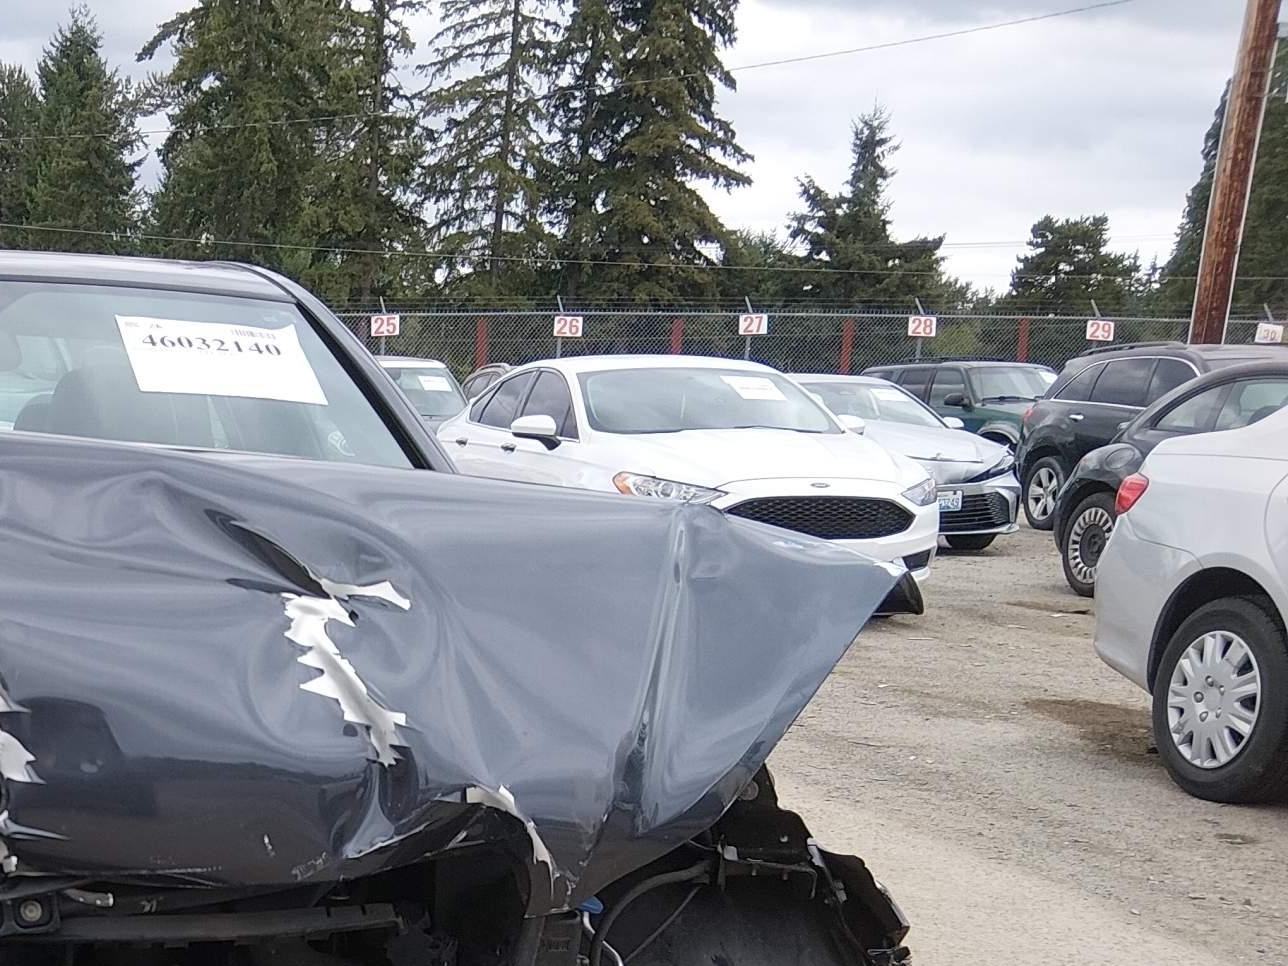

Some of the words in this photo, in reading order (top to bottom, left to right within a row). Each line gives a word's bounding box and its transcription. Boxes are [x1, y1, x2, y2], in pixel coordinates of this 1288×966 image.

[374, 316, 396, 334] 25
[556, 317, 580, 335] 26
[743, 315, 764, 333] 27
[911, 318, 933, 336] 28
[1089, 322, 1112, 339] 29
[1263, 328, 1277, 341] 30
[142, 333, 281, 356] 46032140
